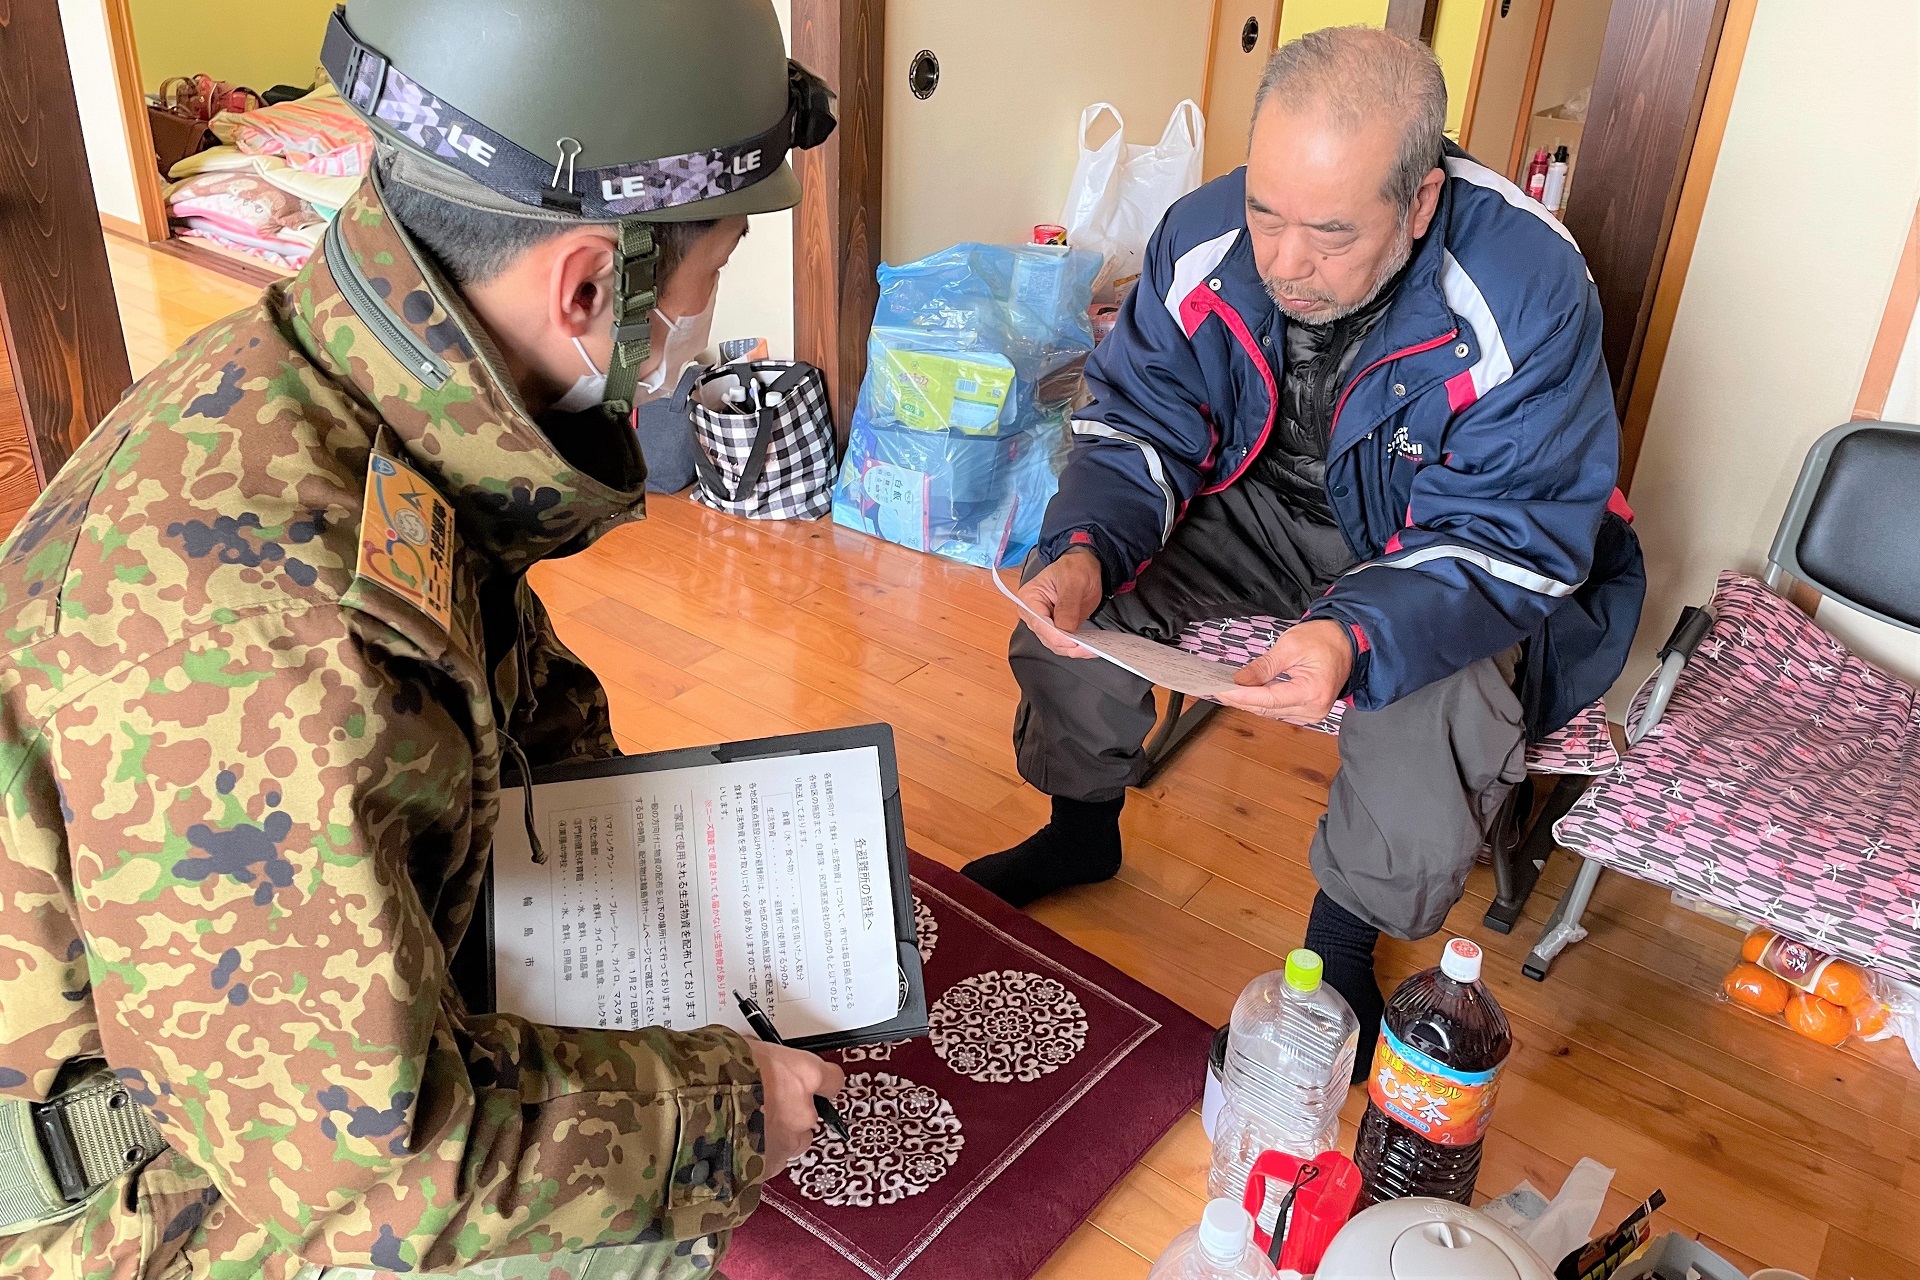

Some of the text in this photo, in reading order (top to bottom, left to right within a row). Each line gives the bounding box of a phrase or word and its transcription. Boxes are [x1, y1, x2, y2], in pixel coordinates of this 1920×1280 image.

[602, 176, 646, 201] LE
[733, 149, 762, 175] LE
[672, 803, 697, 1020] ご家庭で使用される生活物資を配布しております
[855, 837, 875, 930] 各避難所の皆様へ
[1378, 1067, 1451, 1126] むぎ茶
[1381, 1044, 1462, 1099] 健康ミネラル
